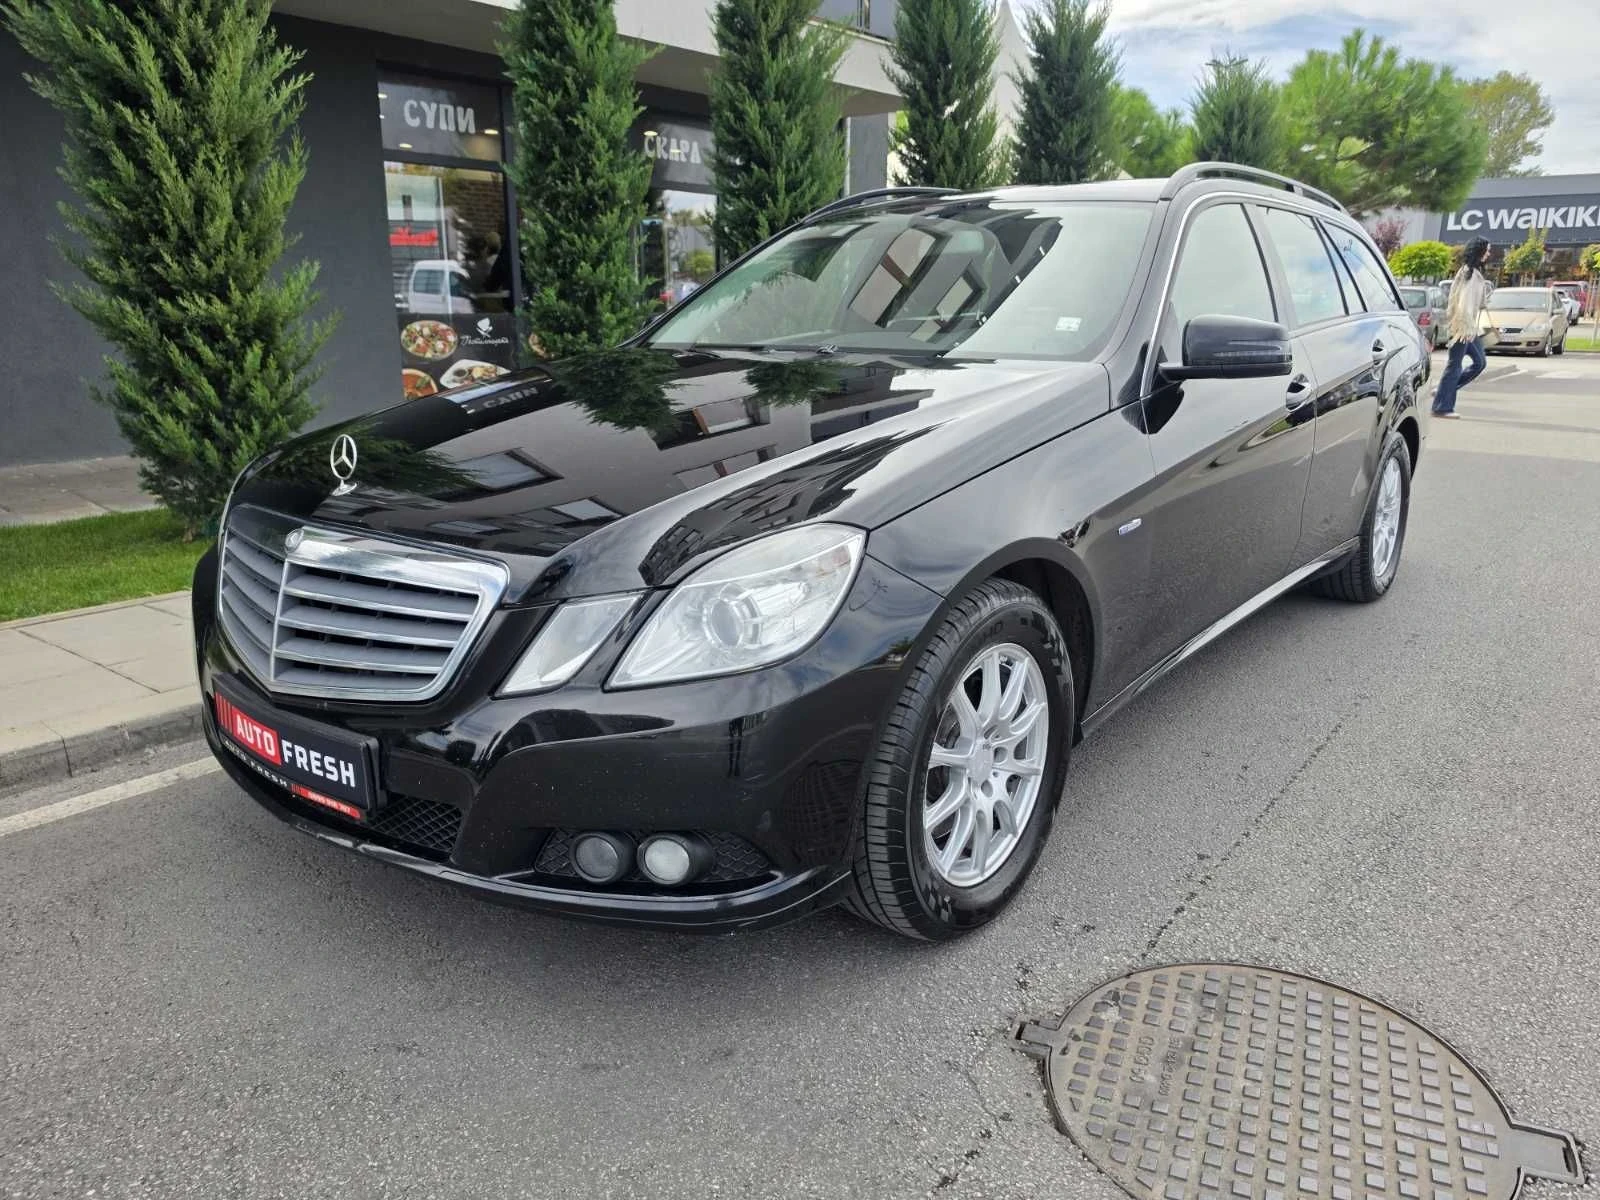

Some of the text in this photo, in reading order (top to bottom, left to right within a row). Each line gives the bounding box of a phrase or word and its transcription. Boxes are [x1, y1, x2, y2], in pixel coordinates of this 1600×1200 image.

[404, 100, 476, 134] СУПИ
[644, 135, 702, 164] СКАРА
[1446, 209, 1483, 231] LC
[236, 714, 356, 788] AUTO FRESH
